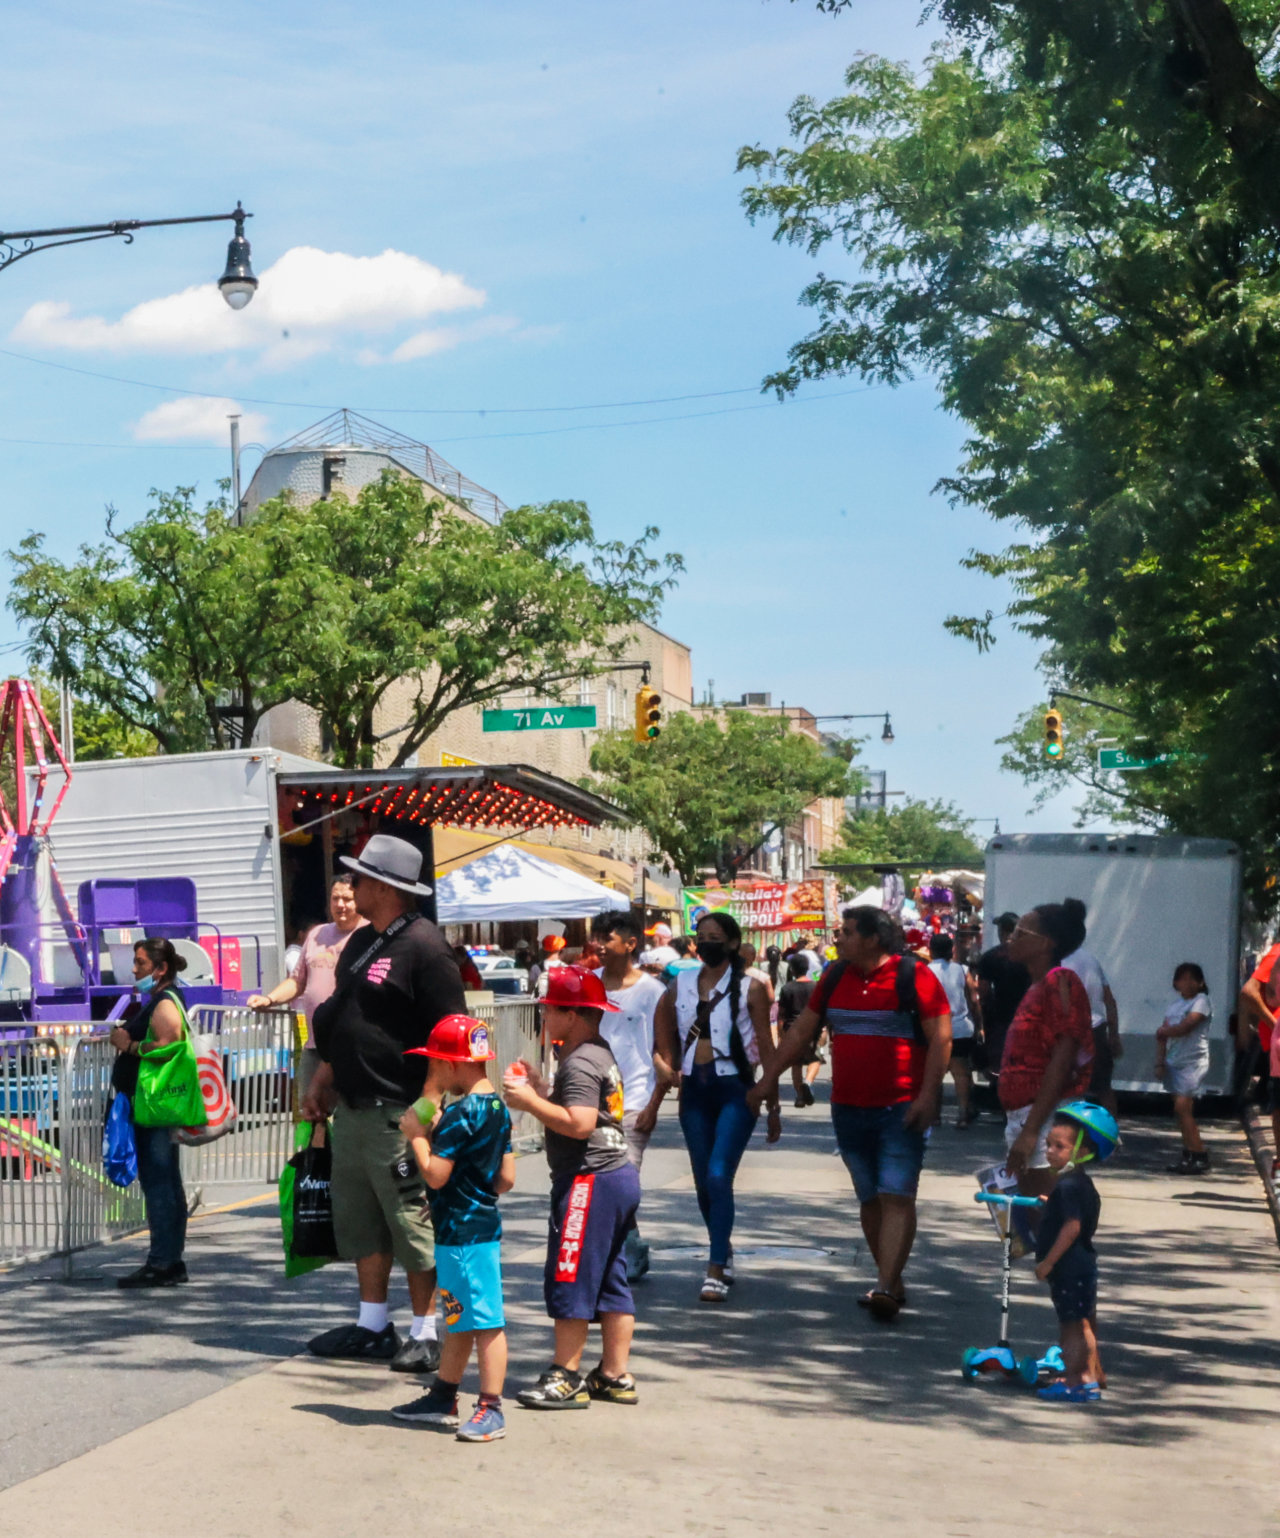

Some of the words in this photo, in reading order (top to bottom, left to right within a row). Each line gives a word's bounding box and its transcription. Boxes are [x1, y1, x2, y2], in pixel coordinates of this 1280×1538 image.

[513, 712, 531, 727] 71
[540, 711, 565, 726] Av
[729, 888, 783, 901] Stella's
[728, 900, 781, 915] ITALIAN
[734, 912, 783, 928] EPPOLE
[570, 1183, 590, 1209] UNDER
[564, 1207, 585, 1240] ARMOUR
